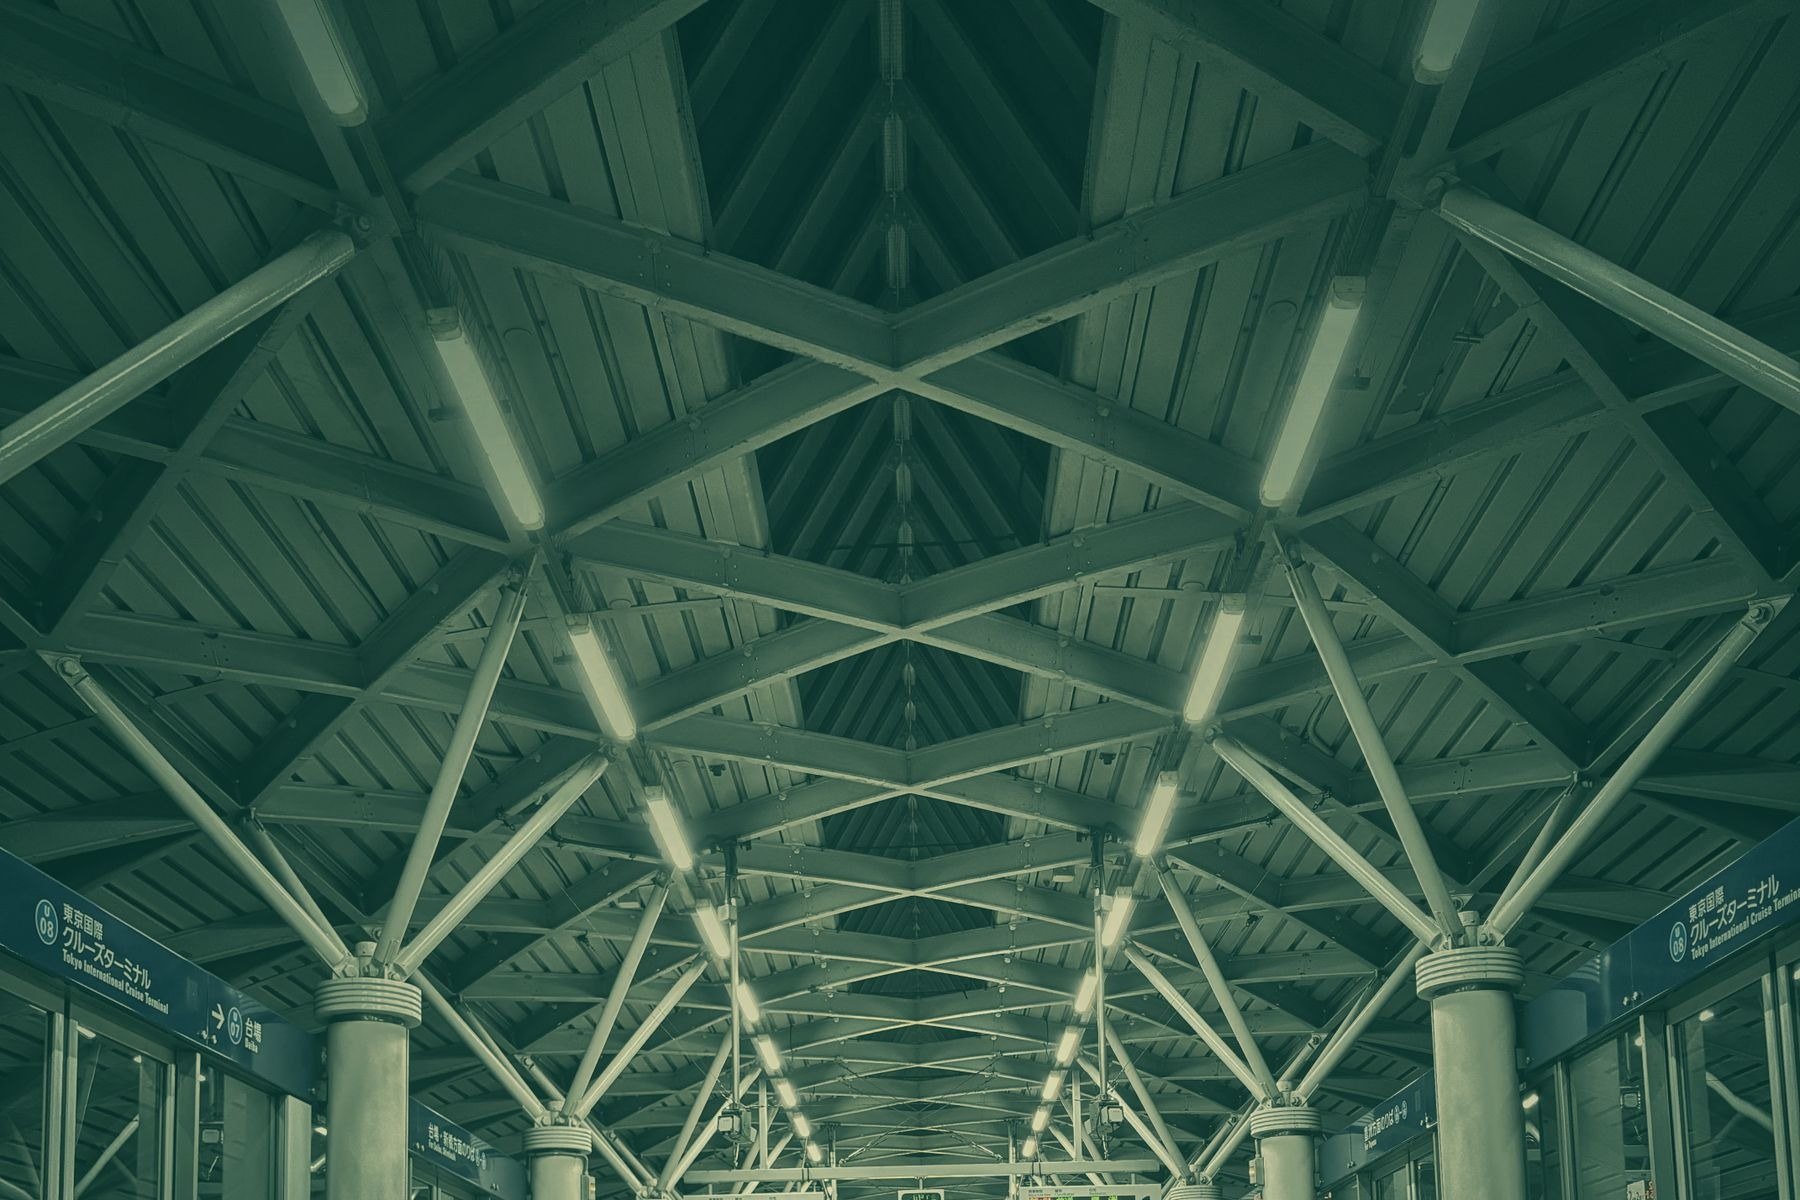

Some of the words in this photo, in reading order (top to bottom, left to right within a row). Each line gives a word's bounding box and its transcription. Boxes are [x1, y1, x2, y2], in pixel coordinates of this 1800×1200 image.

[63, 903, 104, 941] 東京国際
[1689, 885, 1724, 923] 東京国際
[1690, 874, 1780, 946] クルーズターミナル
[40, 917, 54, 938] 08
[1691, 943, 1709, 960] Tokyo
[1709, 915, 1750, 950] International
[1750, 905, 1772, 925] Cruise
[63, 927, 151, 990] クルーズターミナル
[1673, 938, 1684, 956] 08
[62, 948, 83, 970] Tokyo
[83, 960, 124, 992] International
[125, 982, 144, 1002] Cruise
[145, 992, 169, 1015] Terminal
[231, 1022, 239, 1039] 07
